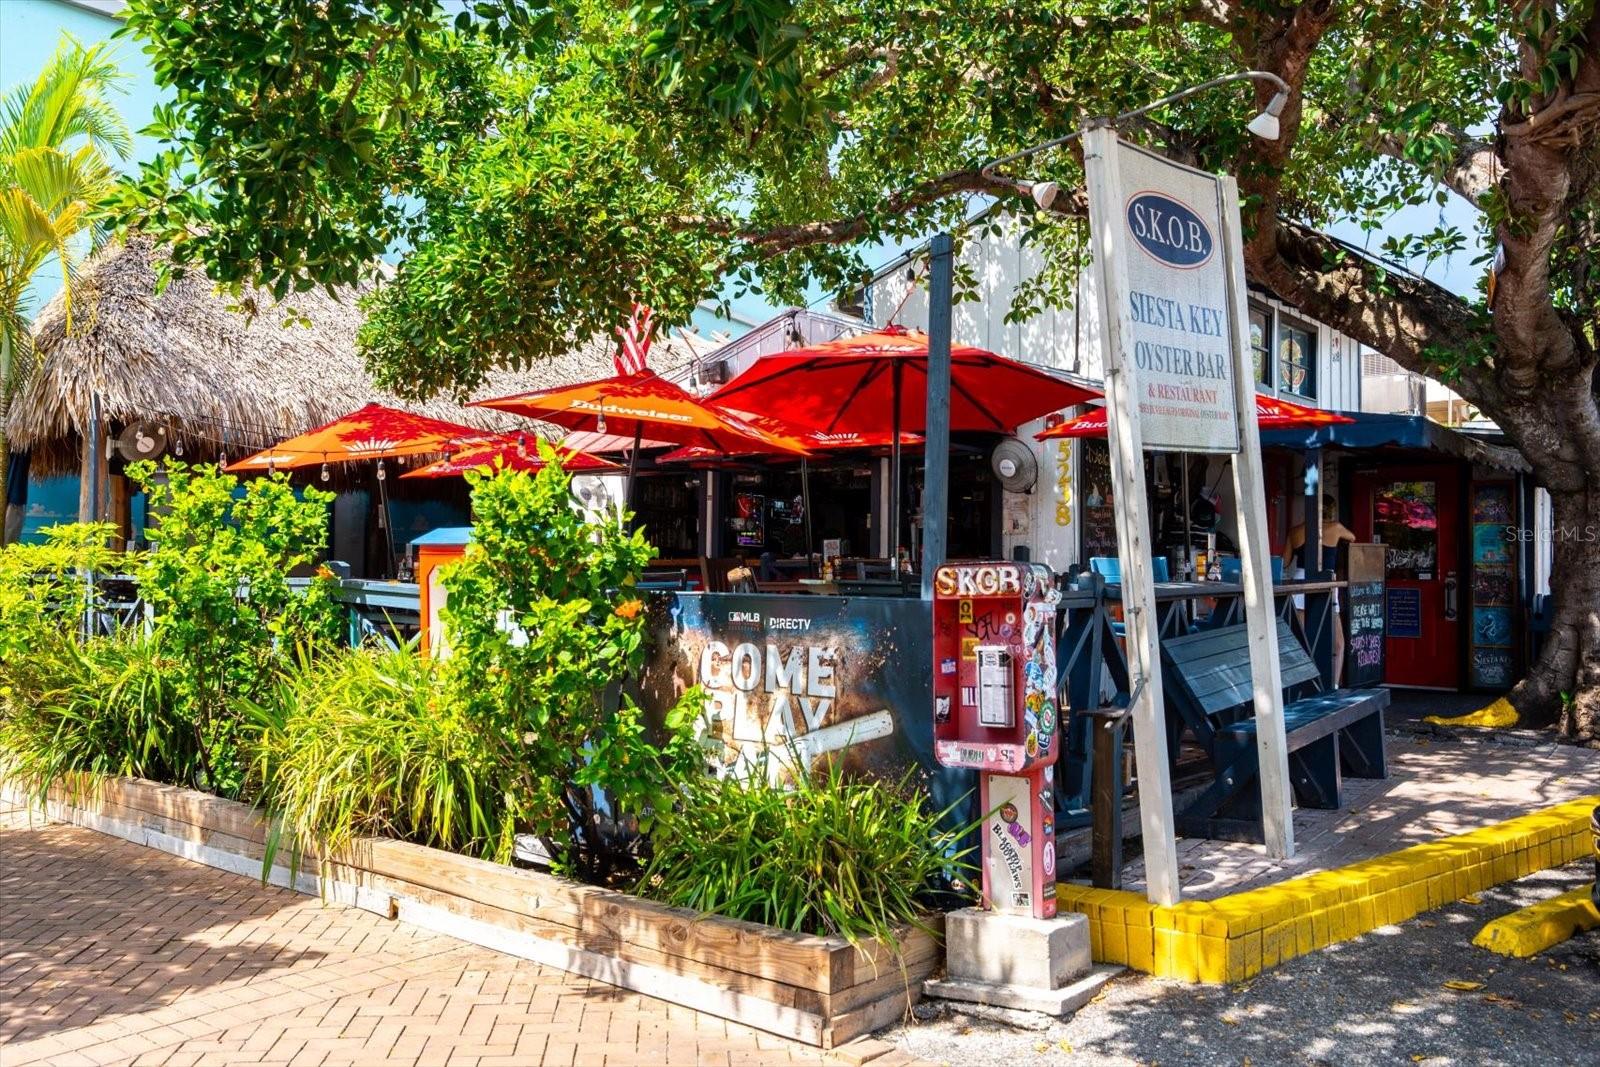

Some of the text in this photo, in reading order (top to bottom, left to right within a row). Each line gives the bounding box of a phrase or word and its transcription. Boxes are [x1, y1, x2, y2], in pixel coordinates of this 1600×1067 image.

[1134, 203, 1207, 255] S.K.O.B.
[1129, 290, 1224, 338] SIESTA KEY
[1135, 340, 1227, 380] OYSTER BAR
[570, 400, 692, 422] Budweiser
[1148, 383, 1218, 405] & RESTAURANT
[936, 565, 1020, 597] SKOB
[740, 612, 761, 624] MLB
[769, 617, 811, 630] DIRECTV
[700, 640, 837, 698] COME
[701, 689, 832, 745] PLAY
